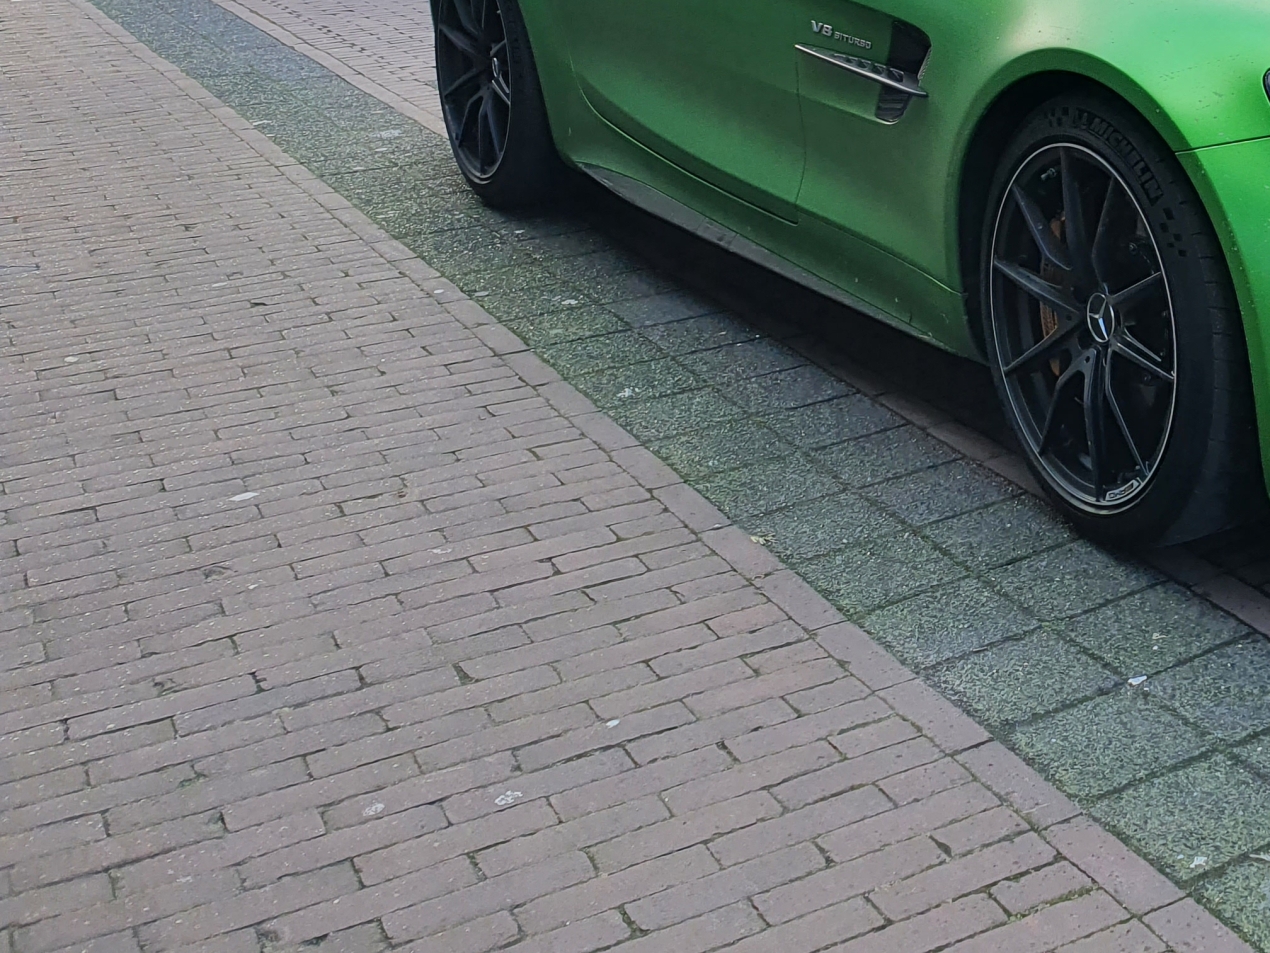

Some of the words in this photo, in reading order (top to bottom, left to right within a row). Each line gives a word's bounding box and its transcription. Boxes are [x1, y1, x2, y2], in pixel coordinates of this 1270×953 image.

[811, 20, 833, 36] V8
[834, 32, 872, 49] BITURBO
[1088, 116, 1164, 203] MICHELIN
